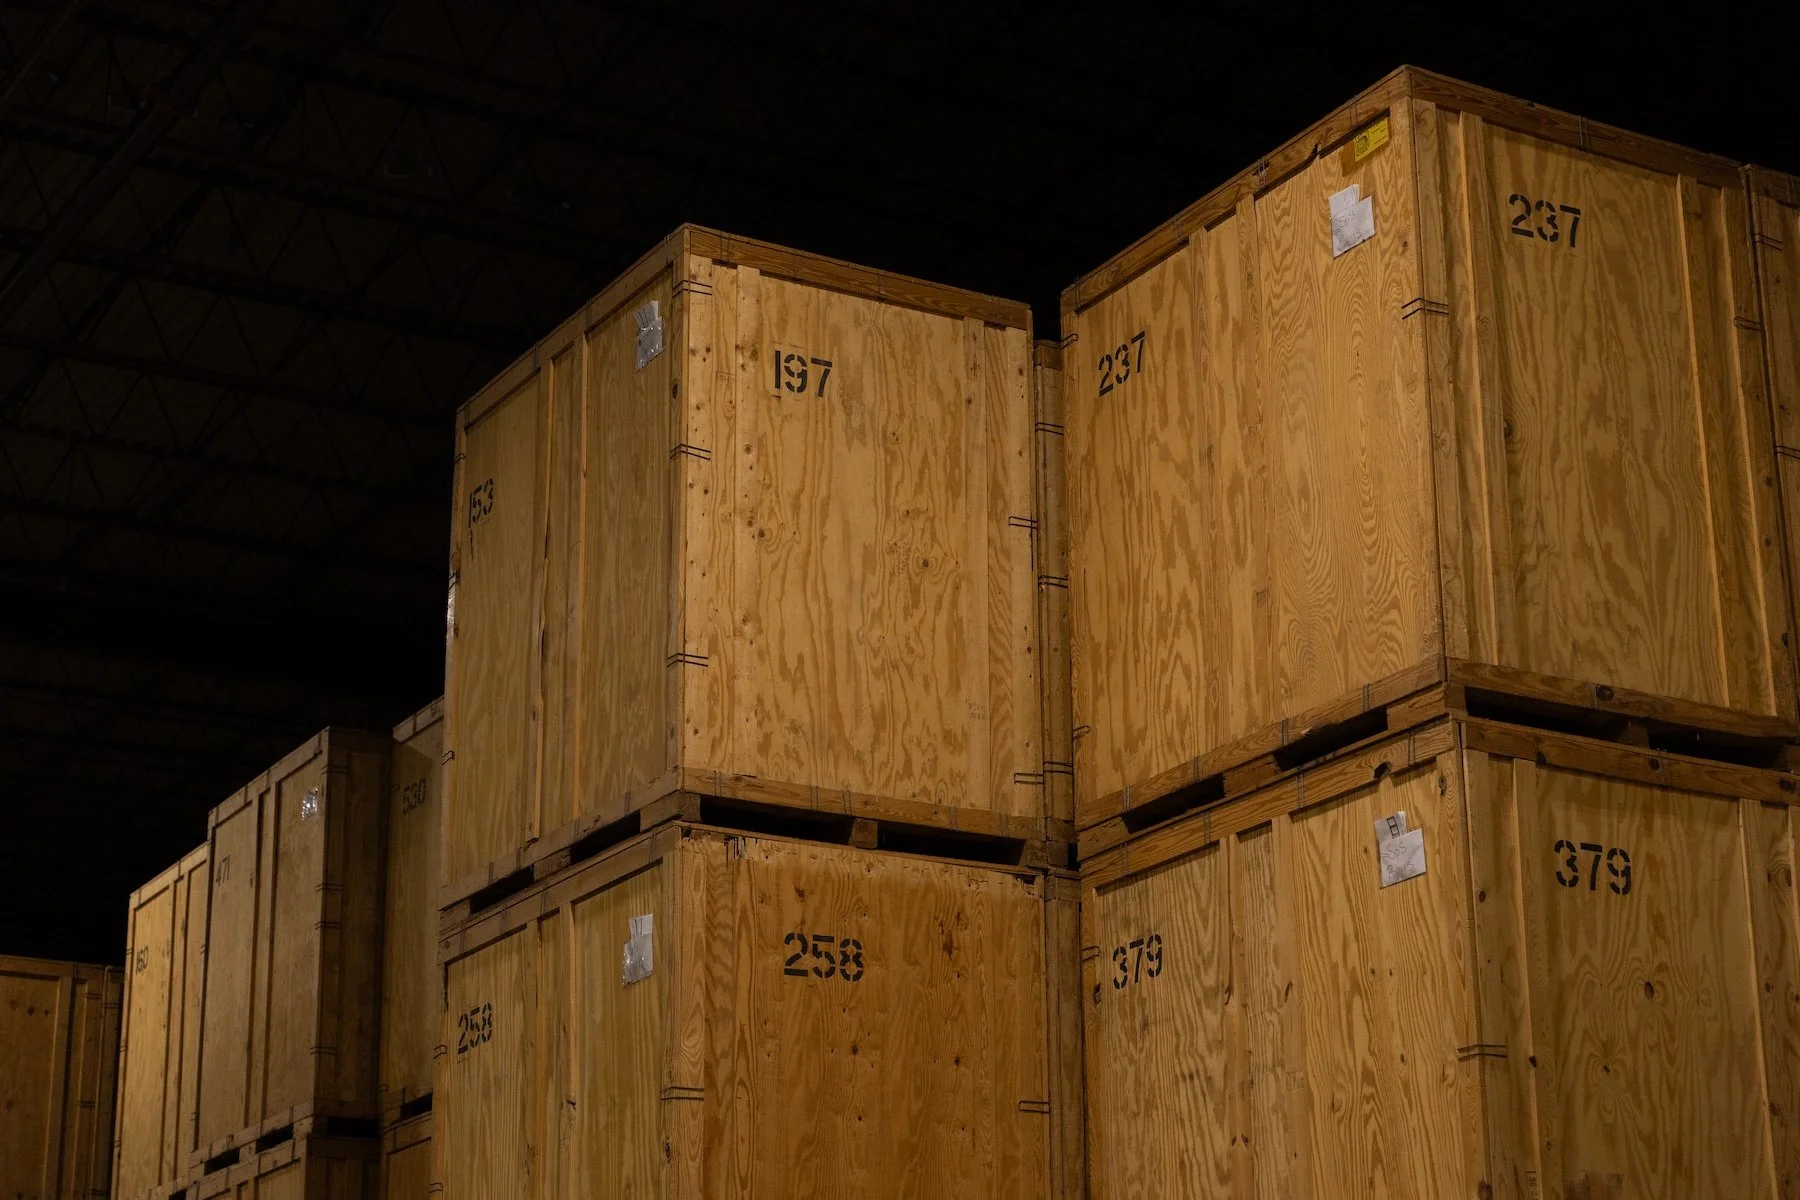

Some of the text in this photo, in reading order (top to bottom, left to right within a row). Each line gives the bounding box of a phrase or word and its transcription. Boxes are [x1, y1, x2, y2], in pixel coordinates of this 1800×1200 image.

[1509, 193, 1581, 248] 237
[774, 350, 832, 398] 197
[1099, 331, 1145, 397] 237
[468, 478, 494, 528] 153
[402, 777, 426, 816] 530
[1554, 839, 1632, 895] 379
[784, 932, 864, 981] 258
[1112, 934, 1163, 990] 379
[458, 1002, 492, 1055] 258
